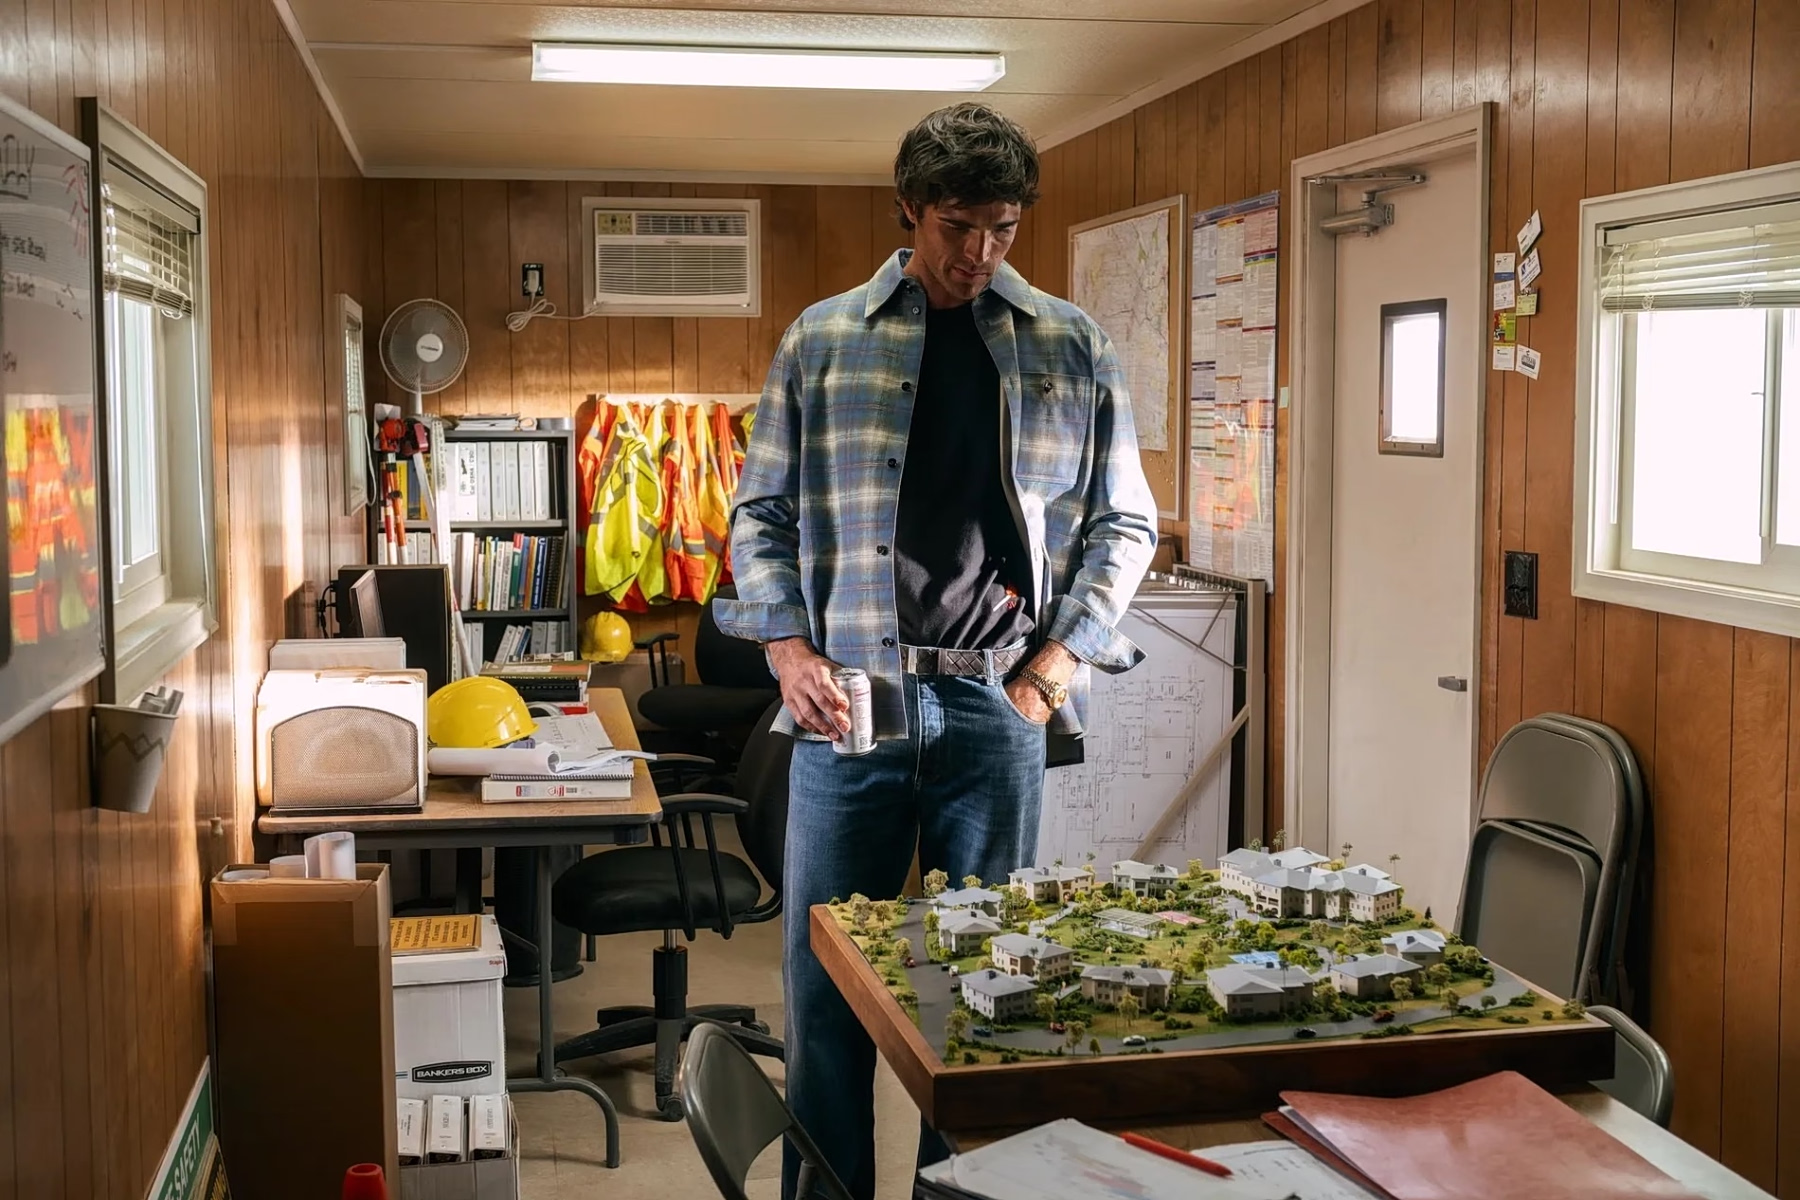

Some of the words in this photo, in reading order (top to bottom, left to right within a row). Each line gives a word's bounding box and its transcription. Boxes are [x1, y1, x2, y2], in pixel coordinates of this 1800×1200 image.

[416, 1067, 465, 1078] BANKERS
[465, 1064, 488, 1075] BOX
[174, 1111, 200, 1200] SAFETY
